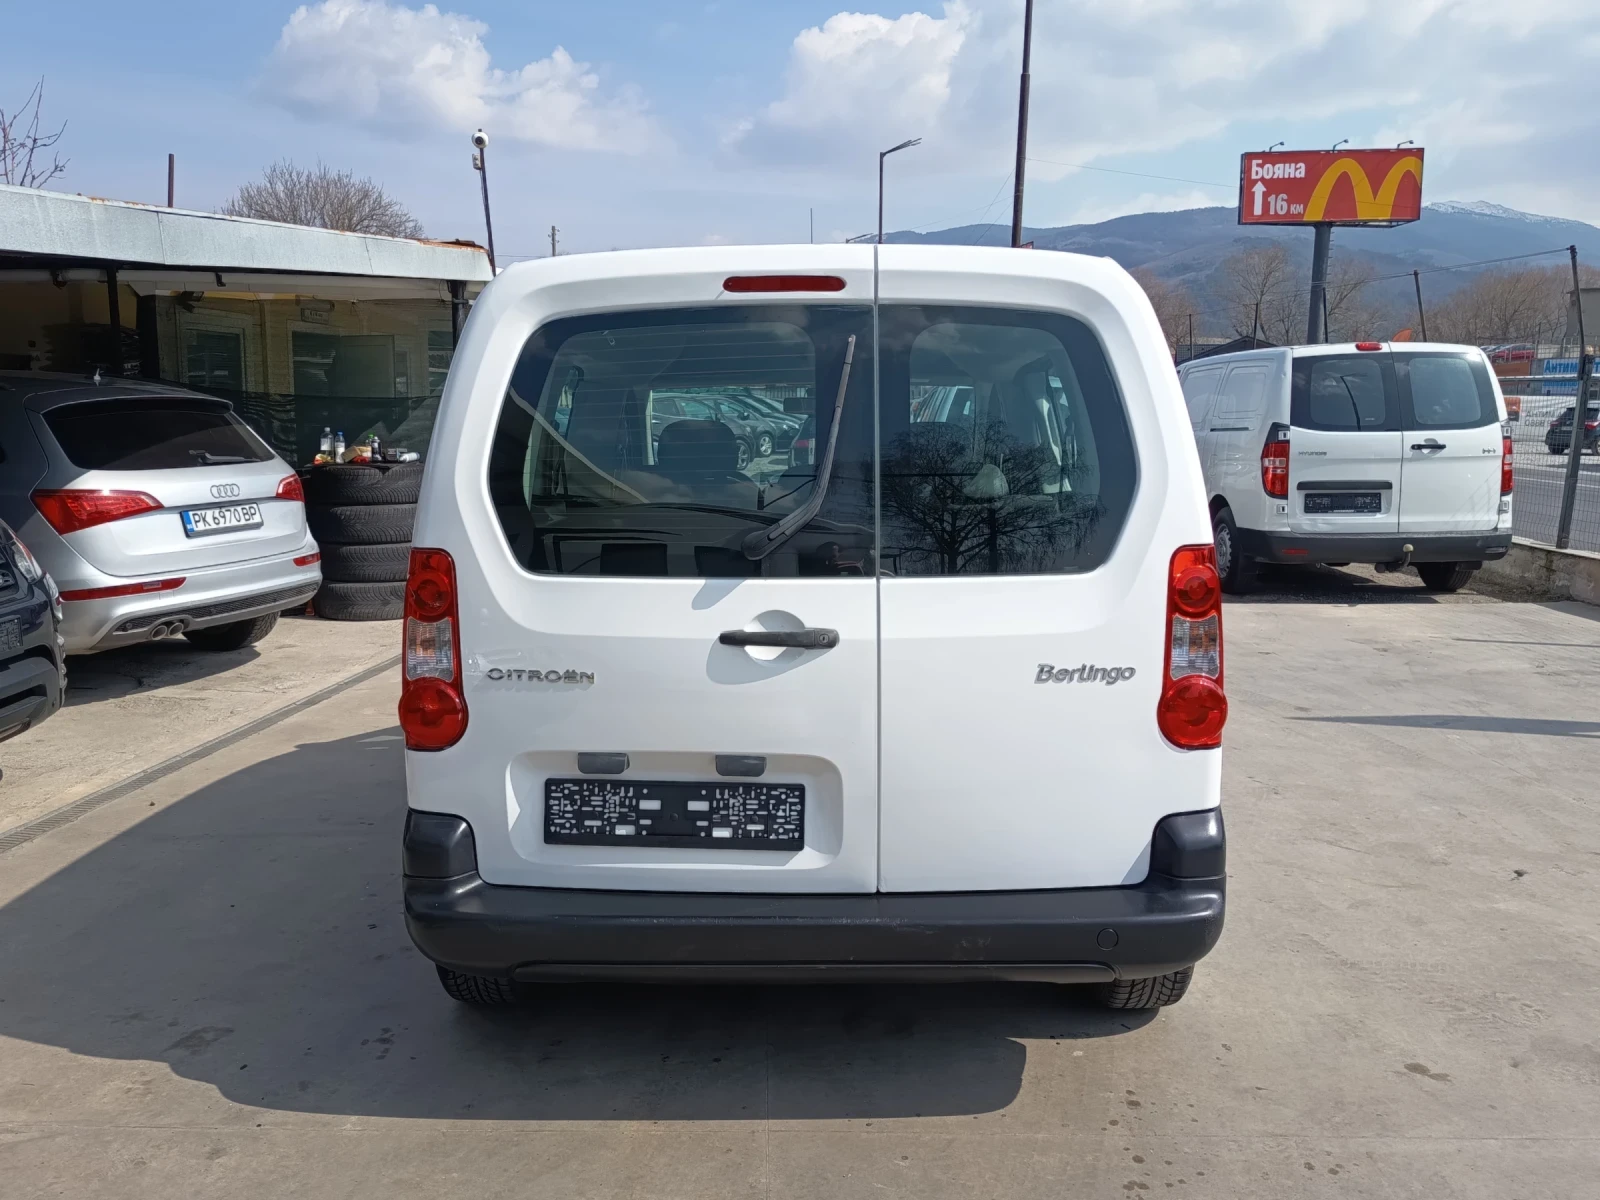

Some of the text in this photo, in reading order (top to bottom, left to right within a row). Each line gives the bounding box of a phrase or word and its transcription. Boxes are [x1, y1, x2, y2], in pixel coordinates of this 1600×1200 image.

[1251, 159, 1305, 180] Бояна
[1268, 194, 1287, 215] 16
[192, 505, 257, 529] PK 6970 BP
[1034, 662, 1136, 686] Berlingo
